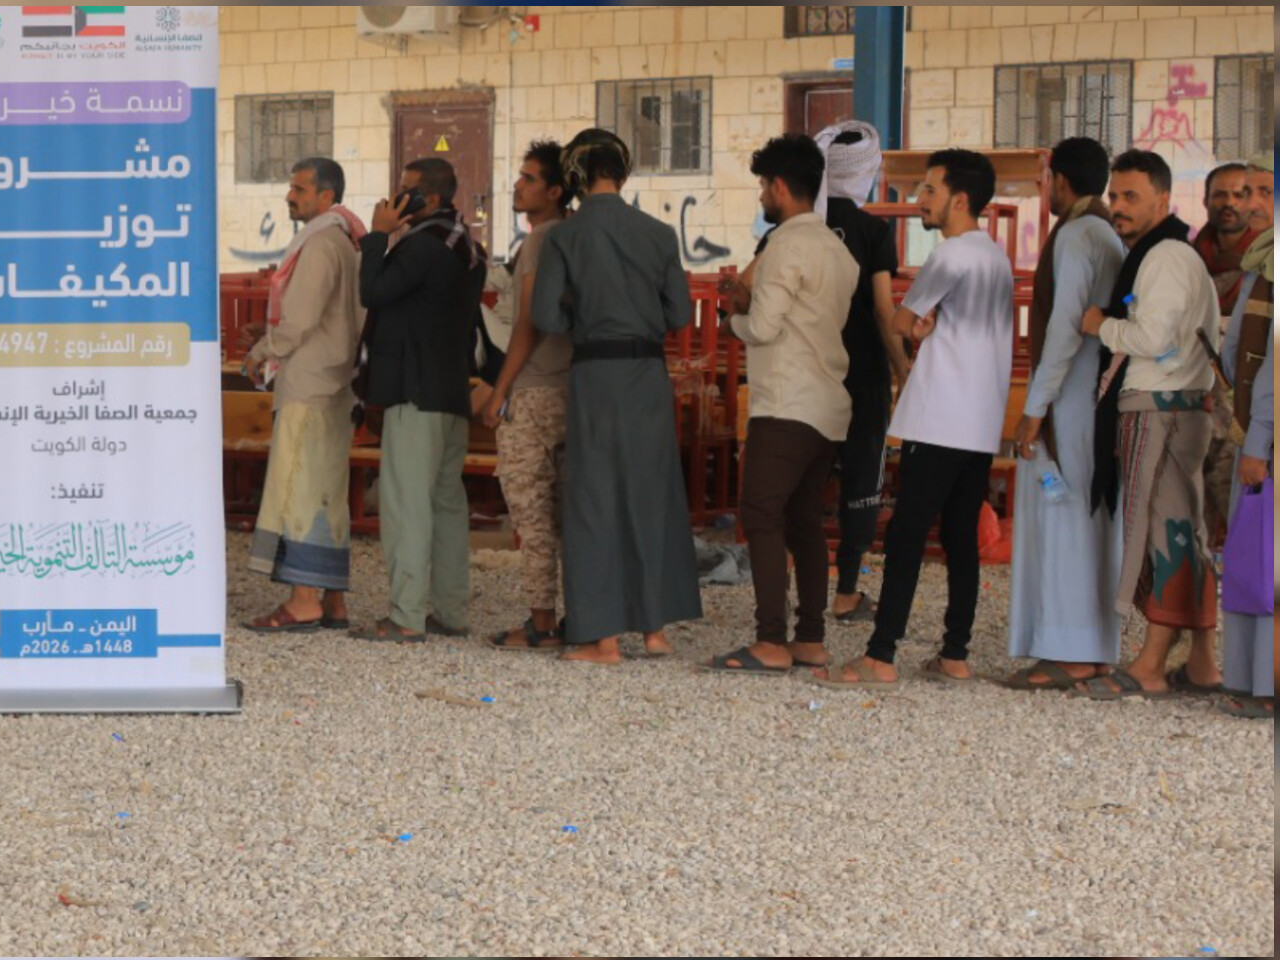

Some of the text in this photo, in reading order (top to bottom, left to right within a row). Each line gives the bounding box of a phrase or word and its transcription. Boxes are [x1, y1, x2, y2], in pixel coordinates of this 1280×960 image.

[0, 89, 76, 121] خير
[86, 87, 183, 113] نسمة
[65, 333, 135, 358] المشروع
[140, 335, 173, 359] رقم
[52, 379, 106, 401] إشراف
[33, 405, 89, 425] الخيرية
[94, 405, 138, 421] الصفا
[143, 405, 198, 425] جمعية
[31, 436, 127, 456] دولة الكويت
[51, 483, 104, 504] تنفيذ:
[23, 611, 74, 637] مأرب
[90, 615, 137, 637] اليمن
